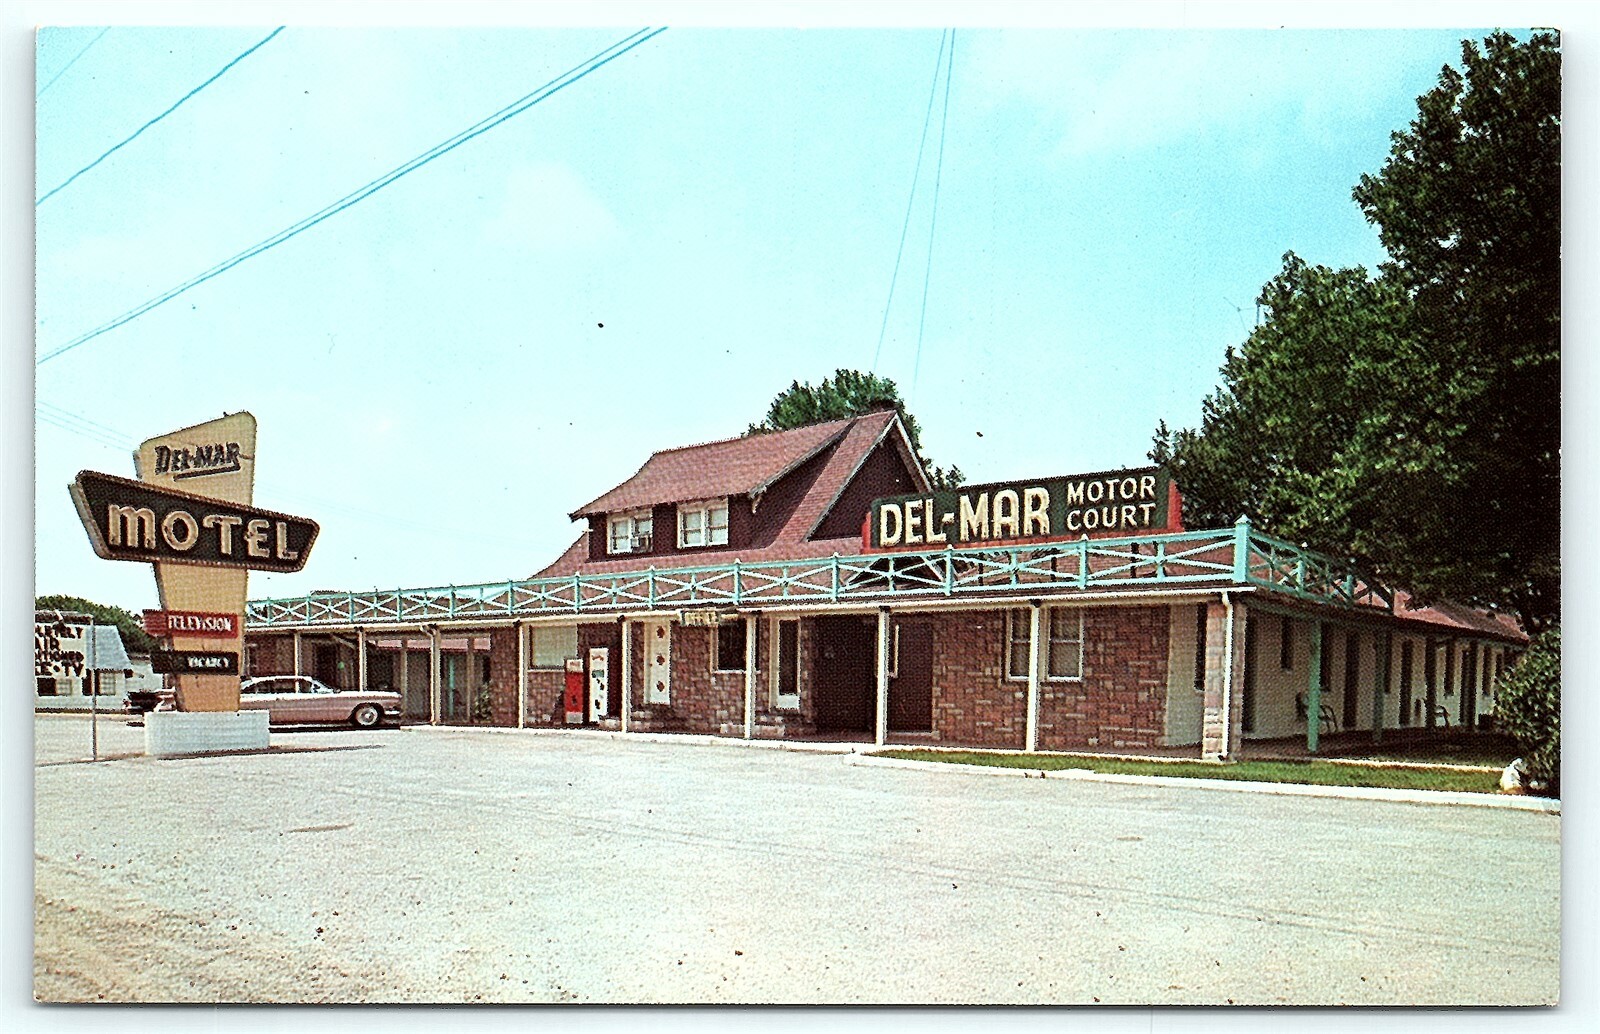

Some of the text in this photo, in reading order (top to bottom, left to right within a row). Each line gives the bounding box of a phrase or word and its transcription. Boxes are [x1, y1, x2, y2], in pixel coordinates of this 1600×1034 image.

[155, 442, 241, 475] DEL-MAR
[1067, 475, 1156, 506] MOTOR
[108, 504, 299, 560] MOTEL
[879, 486, 1051, 548] DEL-MAR
[1066, 502, 1156, 532] COURT
[168, 615, 232, 631] TELEVISION
[187, 656, 229, 668] VACANCY
